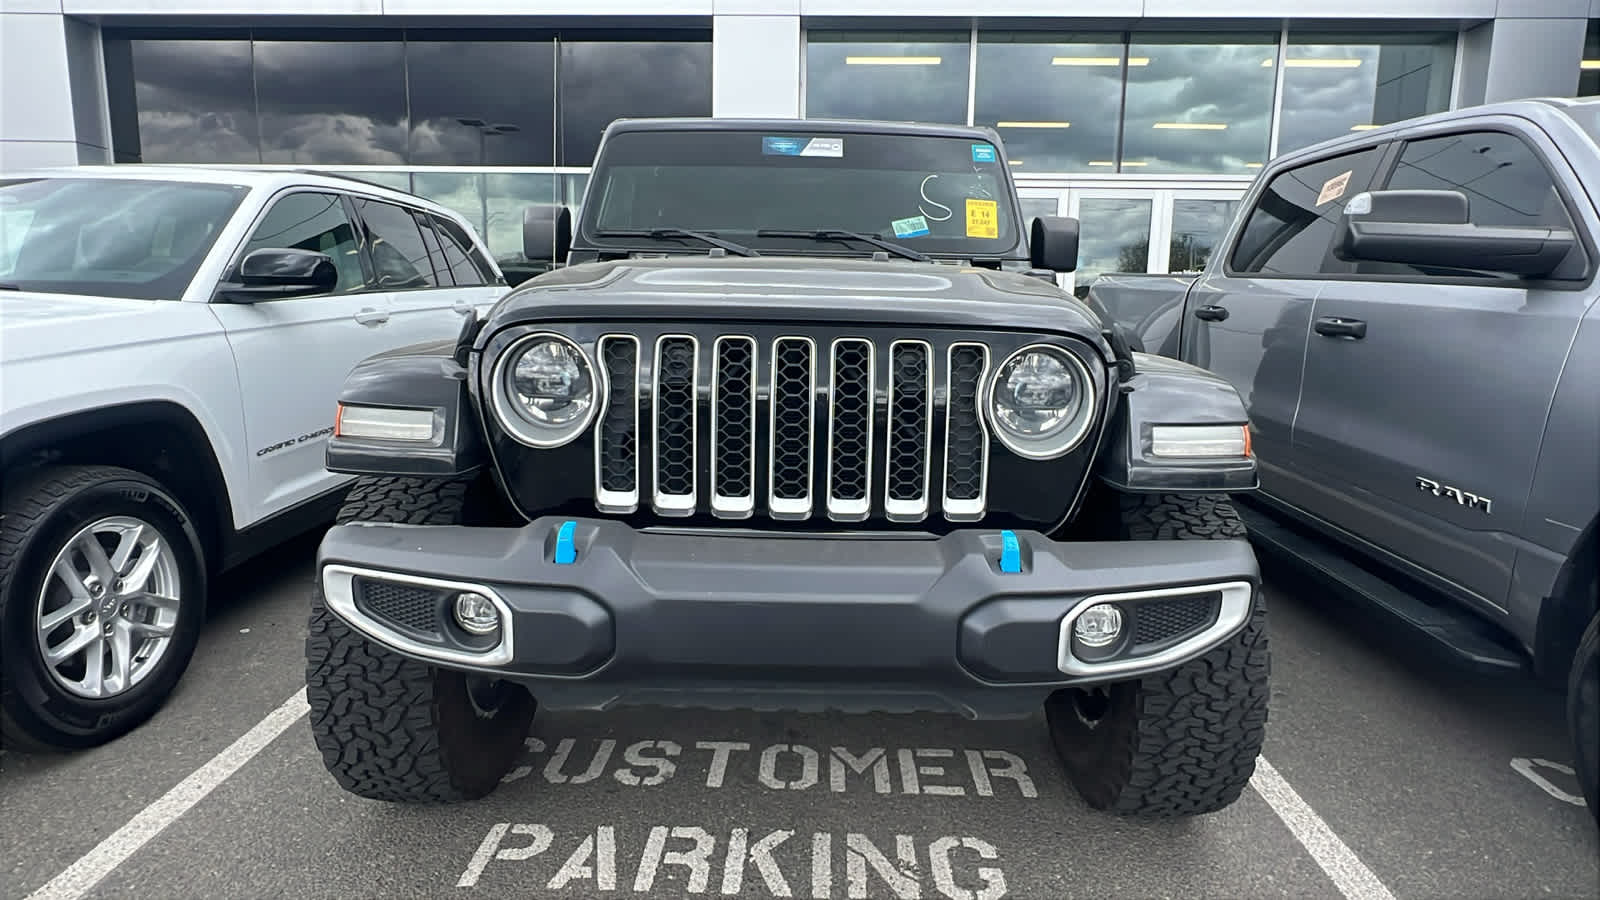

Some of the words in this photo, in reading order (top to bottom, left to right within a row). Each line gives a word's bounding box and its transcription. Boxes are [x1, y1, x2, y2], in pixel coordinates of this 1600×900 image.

[918, 174, 953, 221] S
[256, 438, 296, 457] GRAND
[1415, 475, 1492, 513] RAM
[455, 822, 1008, 900] PARKING
